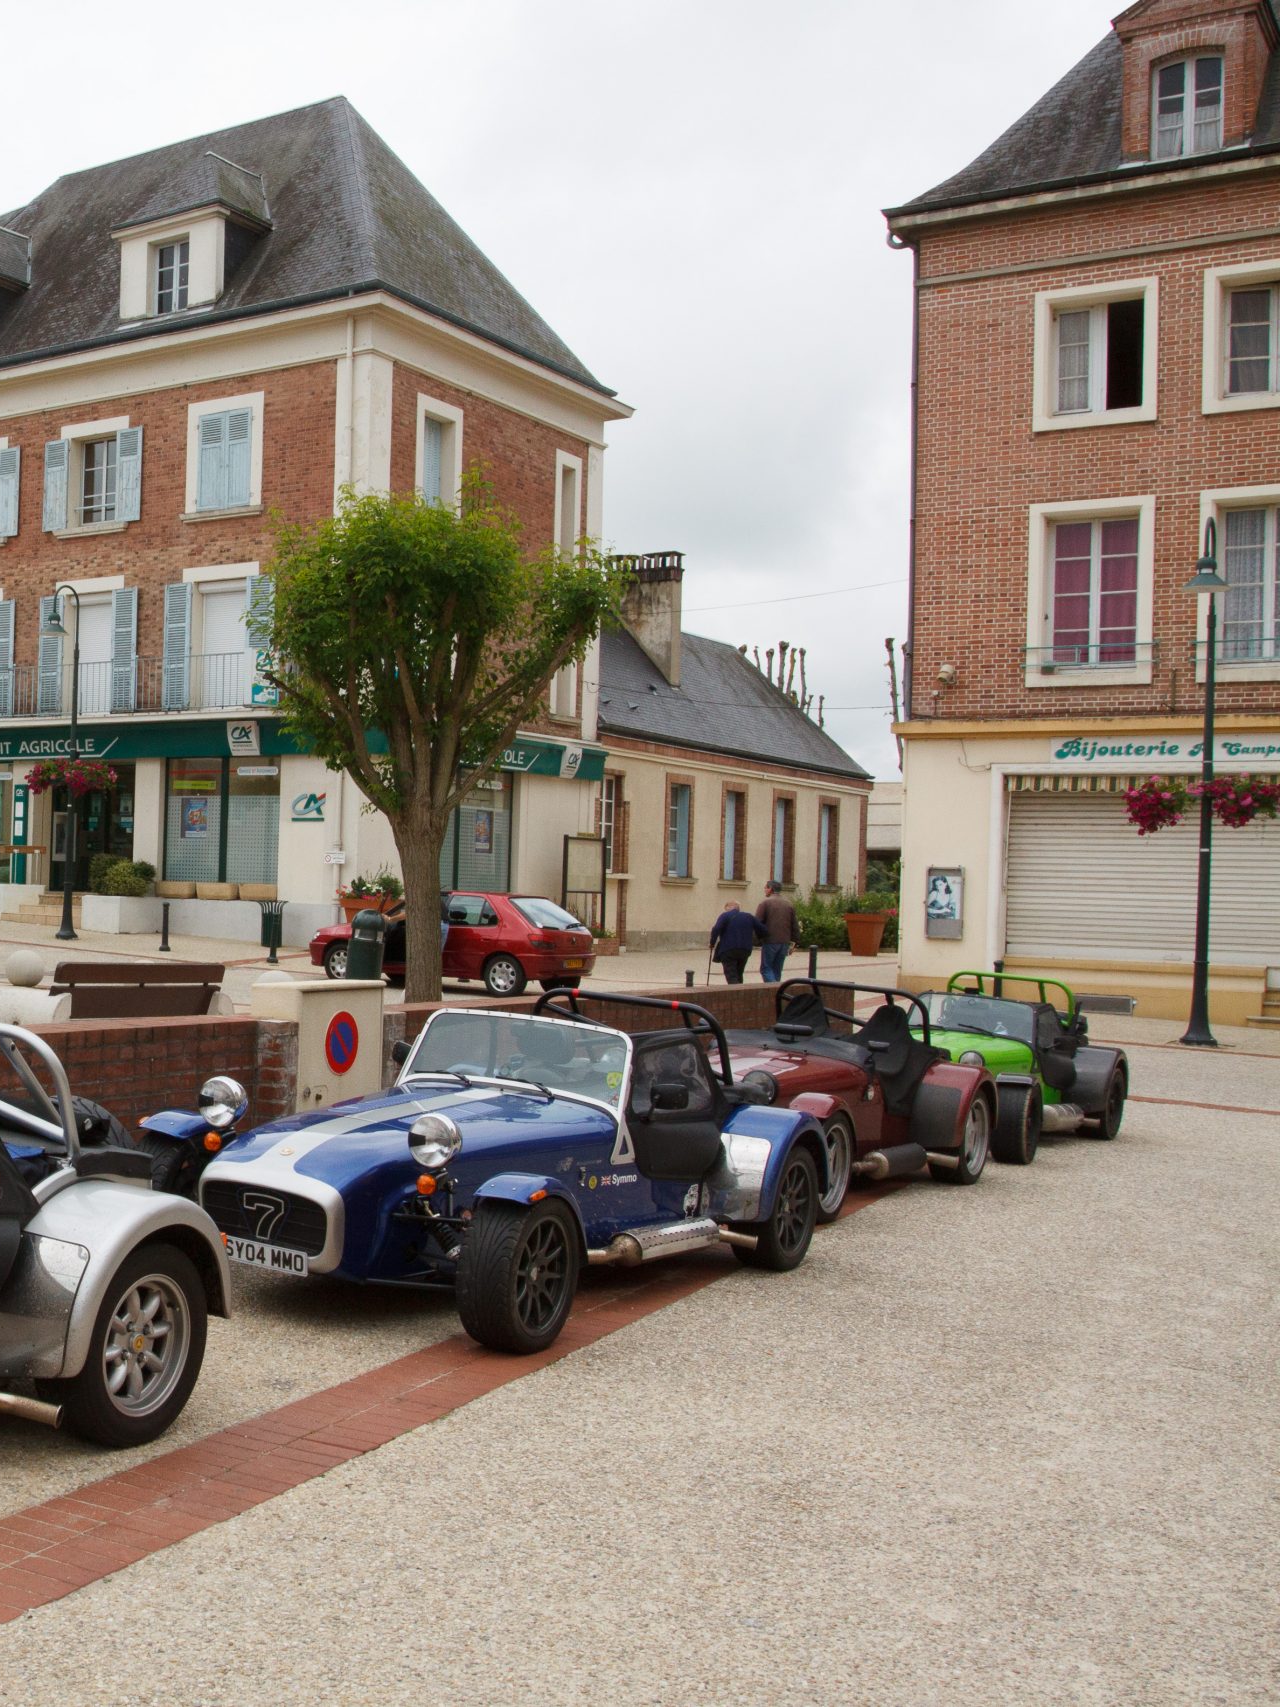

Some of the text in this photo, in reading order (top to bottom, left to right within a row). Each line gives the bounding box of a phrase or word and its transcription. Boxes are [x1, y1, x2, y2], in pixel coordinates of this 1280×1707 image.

[1055, 737, 1179, 761] Bijouterie
[611, 1174, 638, 1187] Symmo
[243, 1192, 285, 1240] 7
[226, 1238, 304, 1273] SY04 MMO
